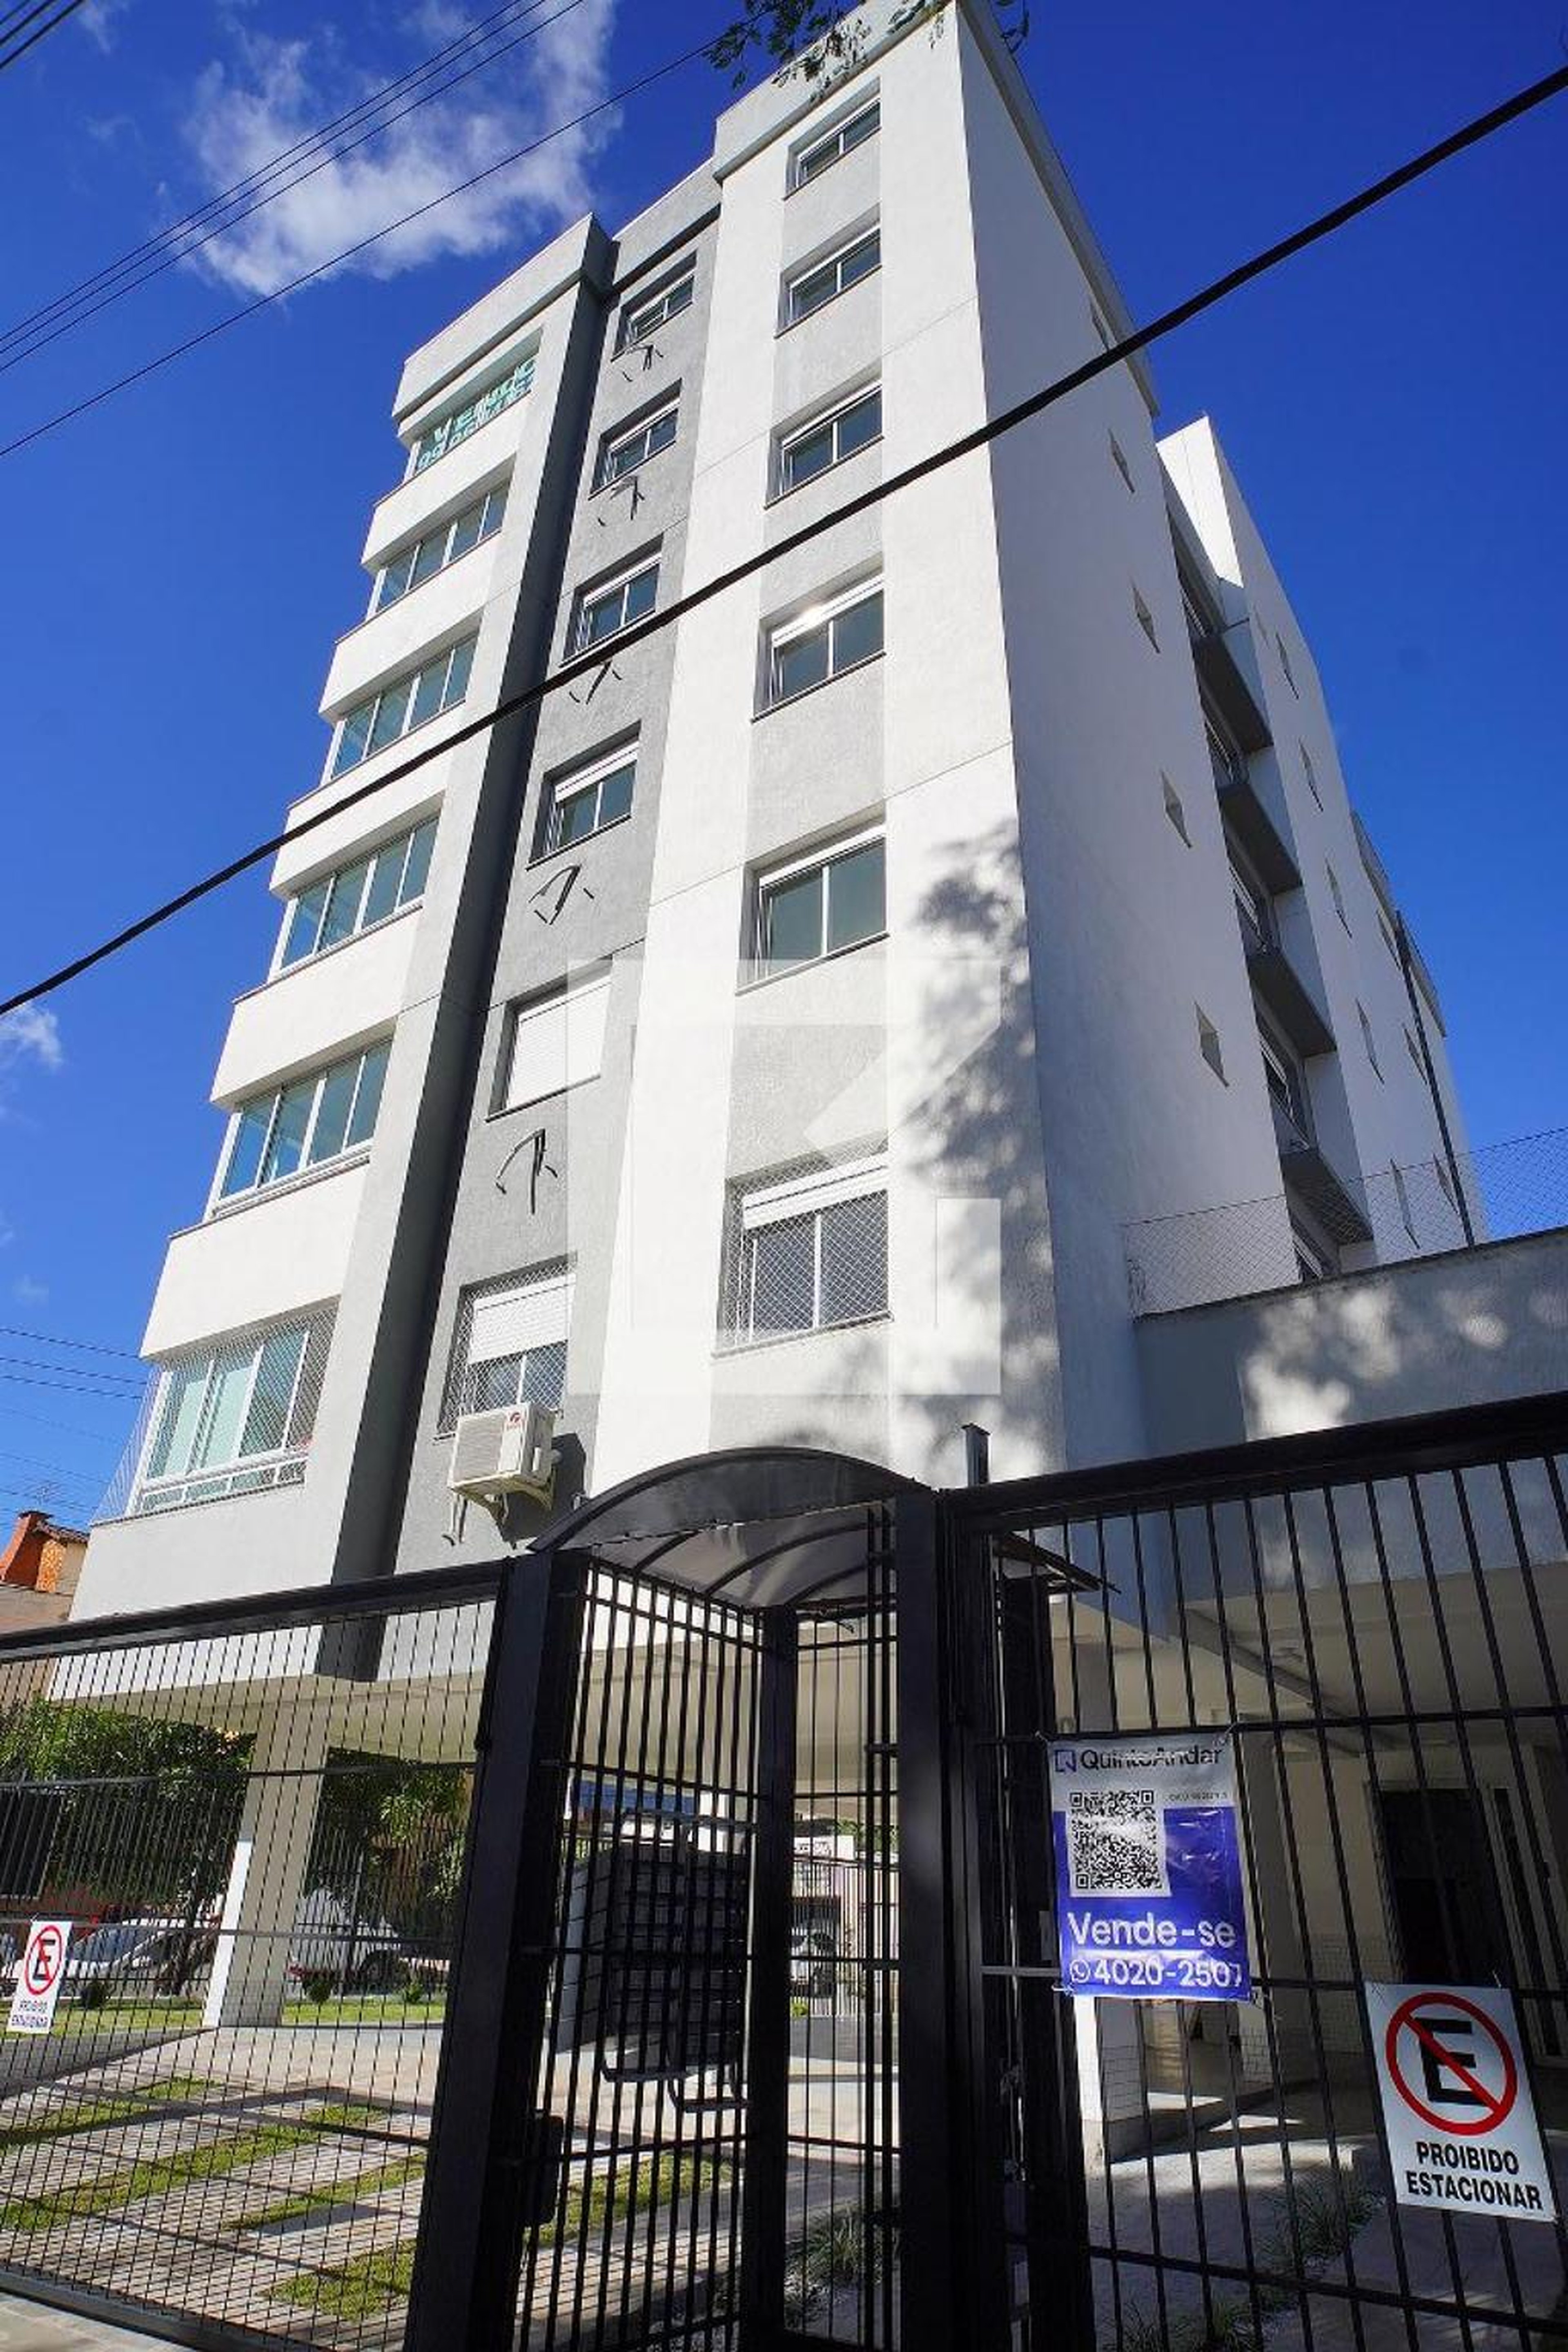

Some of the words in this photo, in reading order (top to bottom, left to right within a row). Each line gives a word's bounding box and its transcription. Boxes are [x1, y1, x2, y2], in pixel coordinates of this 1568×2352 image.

[1080, 1746, 1223, 1771] QuintoAndar
[1068, 1912, 1236, 1948] Vende-se
[1416, 2141, 1519, 2175] PROIBIDO
[1406, 2171, 1543, 2210] ESTACIONAR
